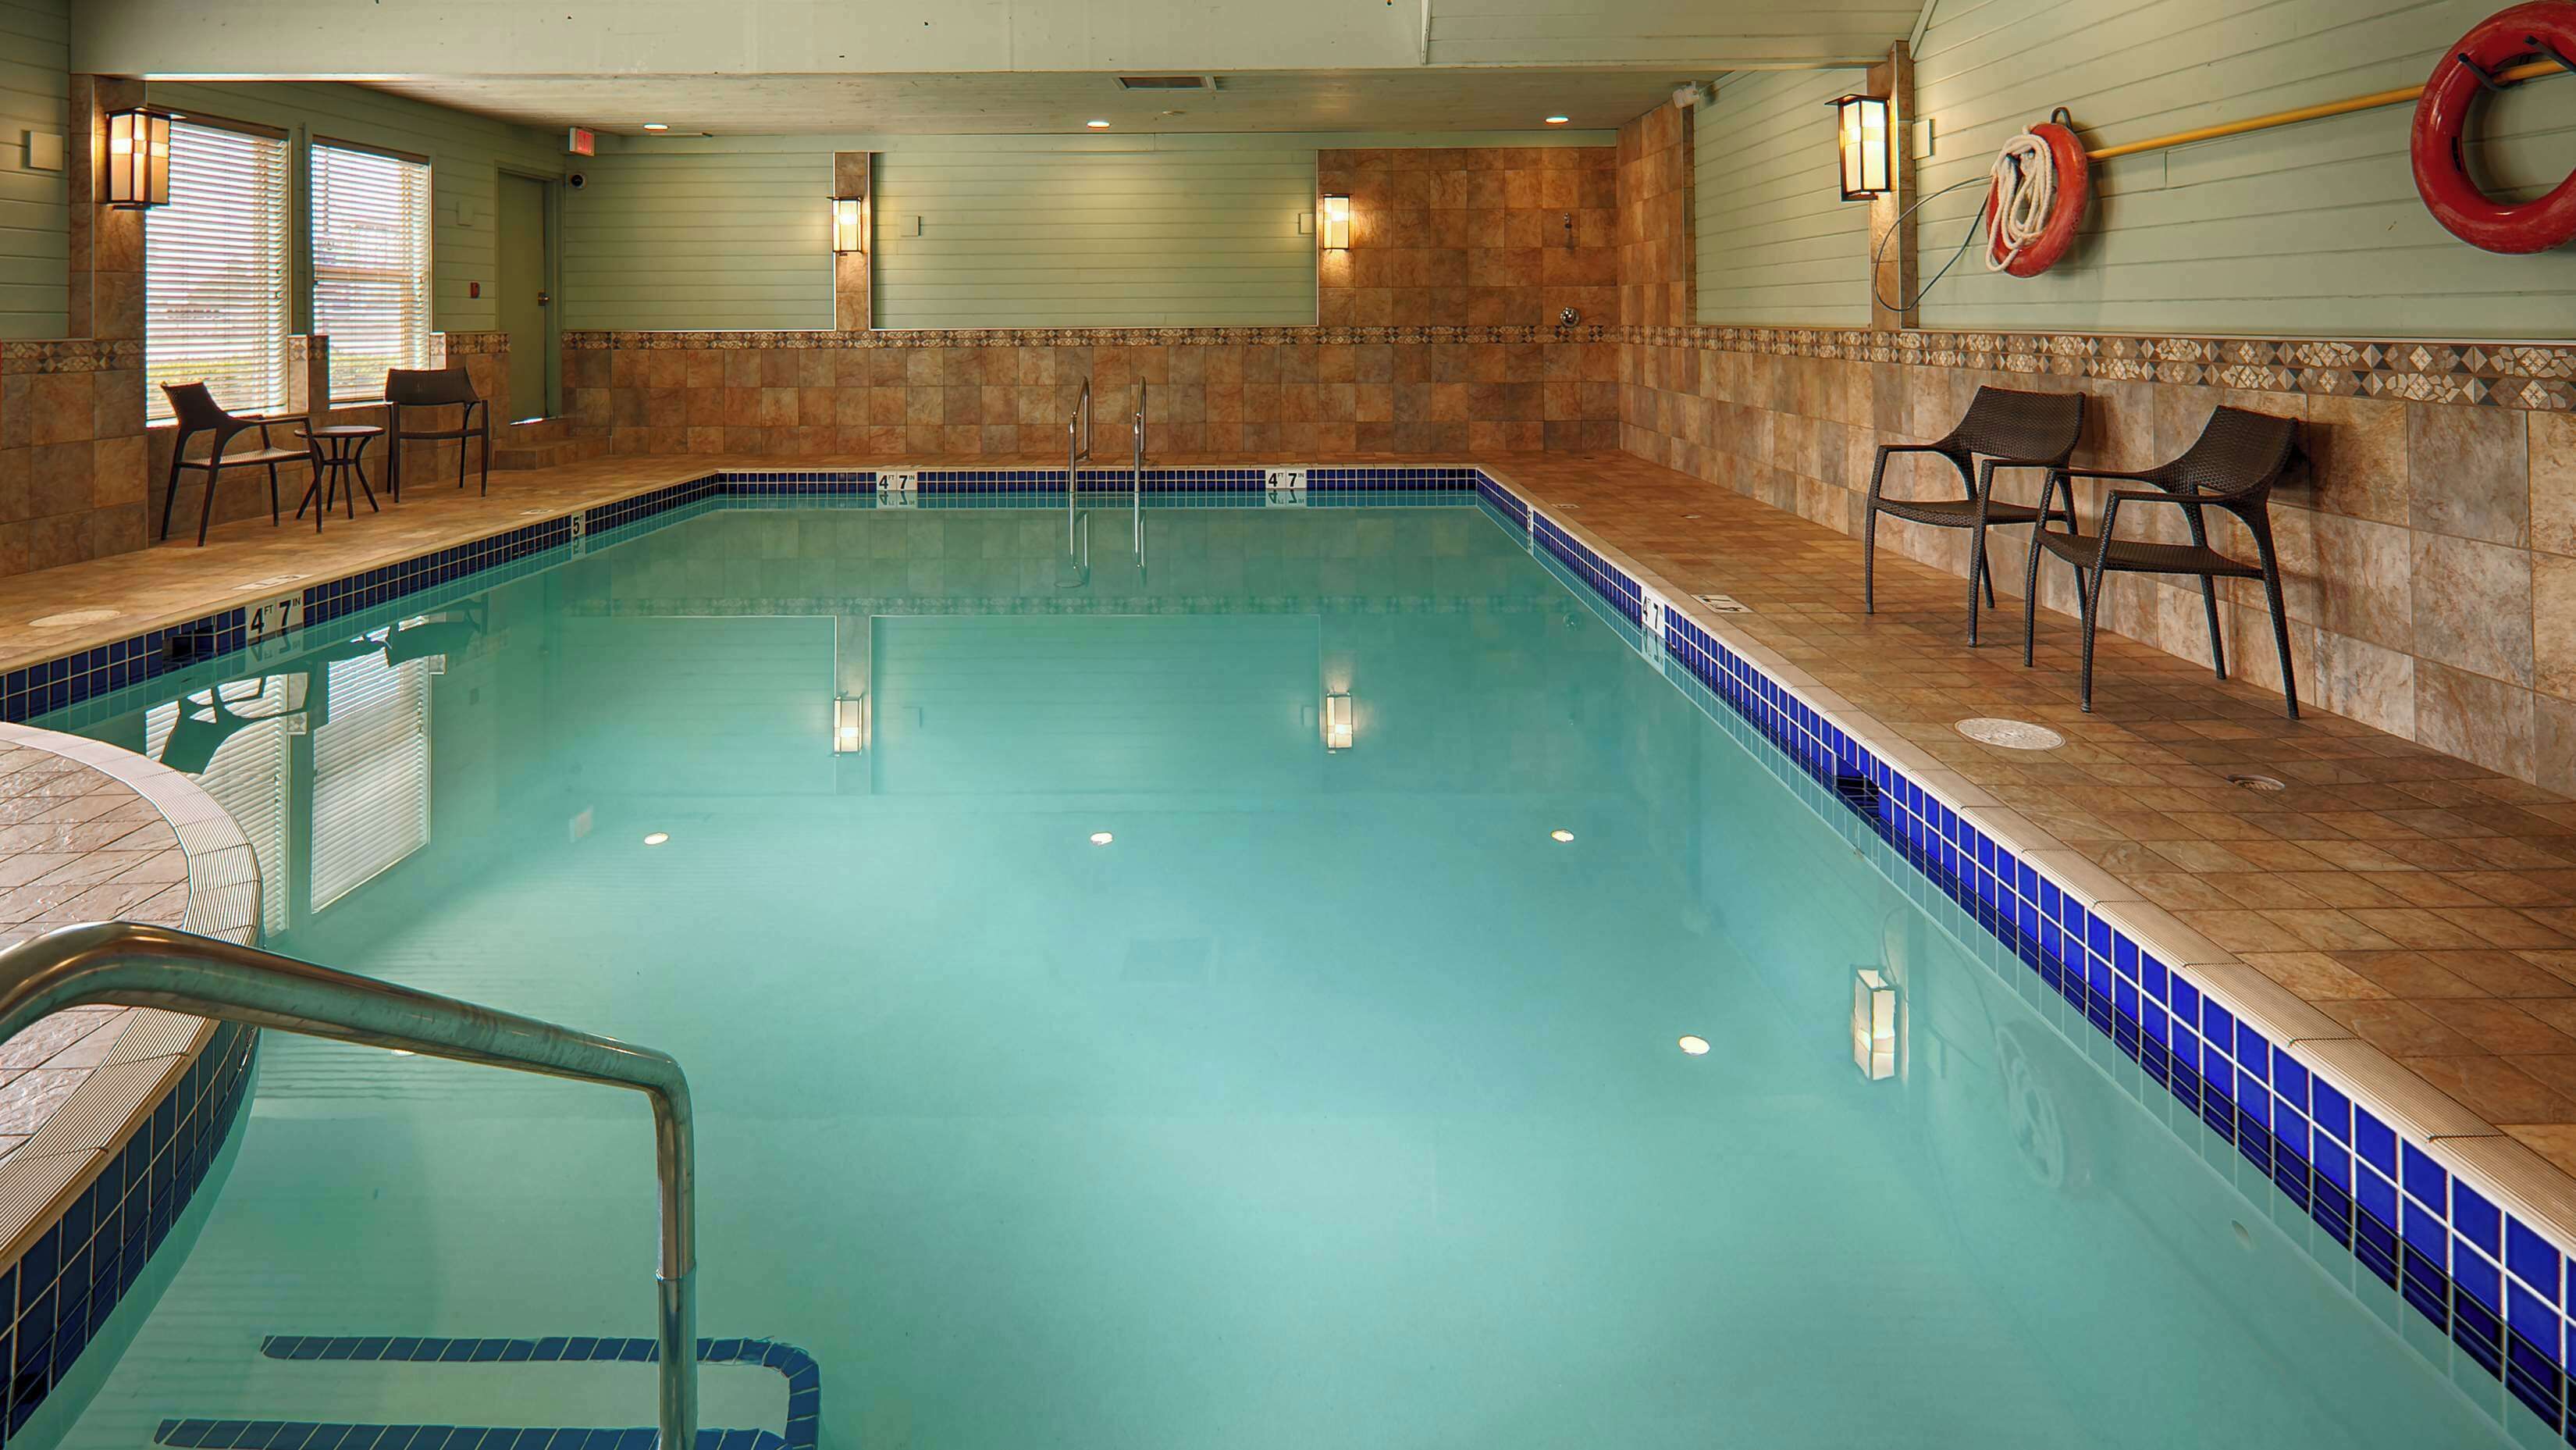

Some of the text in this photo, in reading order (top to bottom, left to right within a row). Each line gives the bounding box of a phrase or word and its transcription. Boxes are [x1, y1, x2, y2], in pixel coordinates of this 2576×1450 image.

[879, 475, 888, 489] 4
[899, 475, 908, 489] 7
[1268, 473, 1278, 487] 4
[1288, 473, 1297, 487] 7
[573, 516, 580, 534] 5
[251, 596, 301, 634] 4 FT 7 IN
[1642, 596, 1658, 629] 4 7
